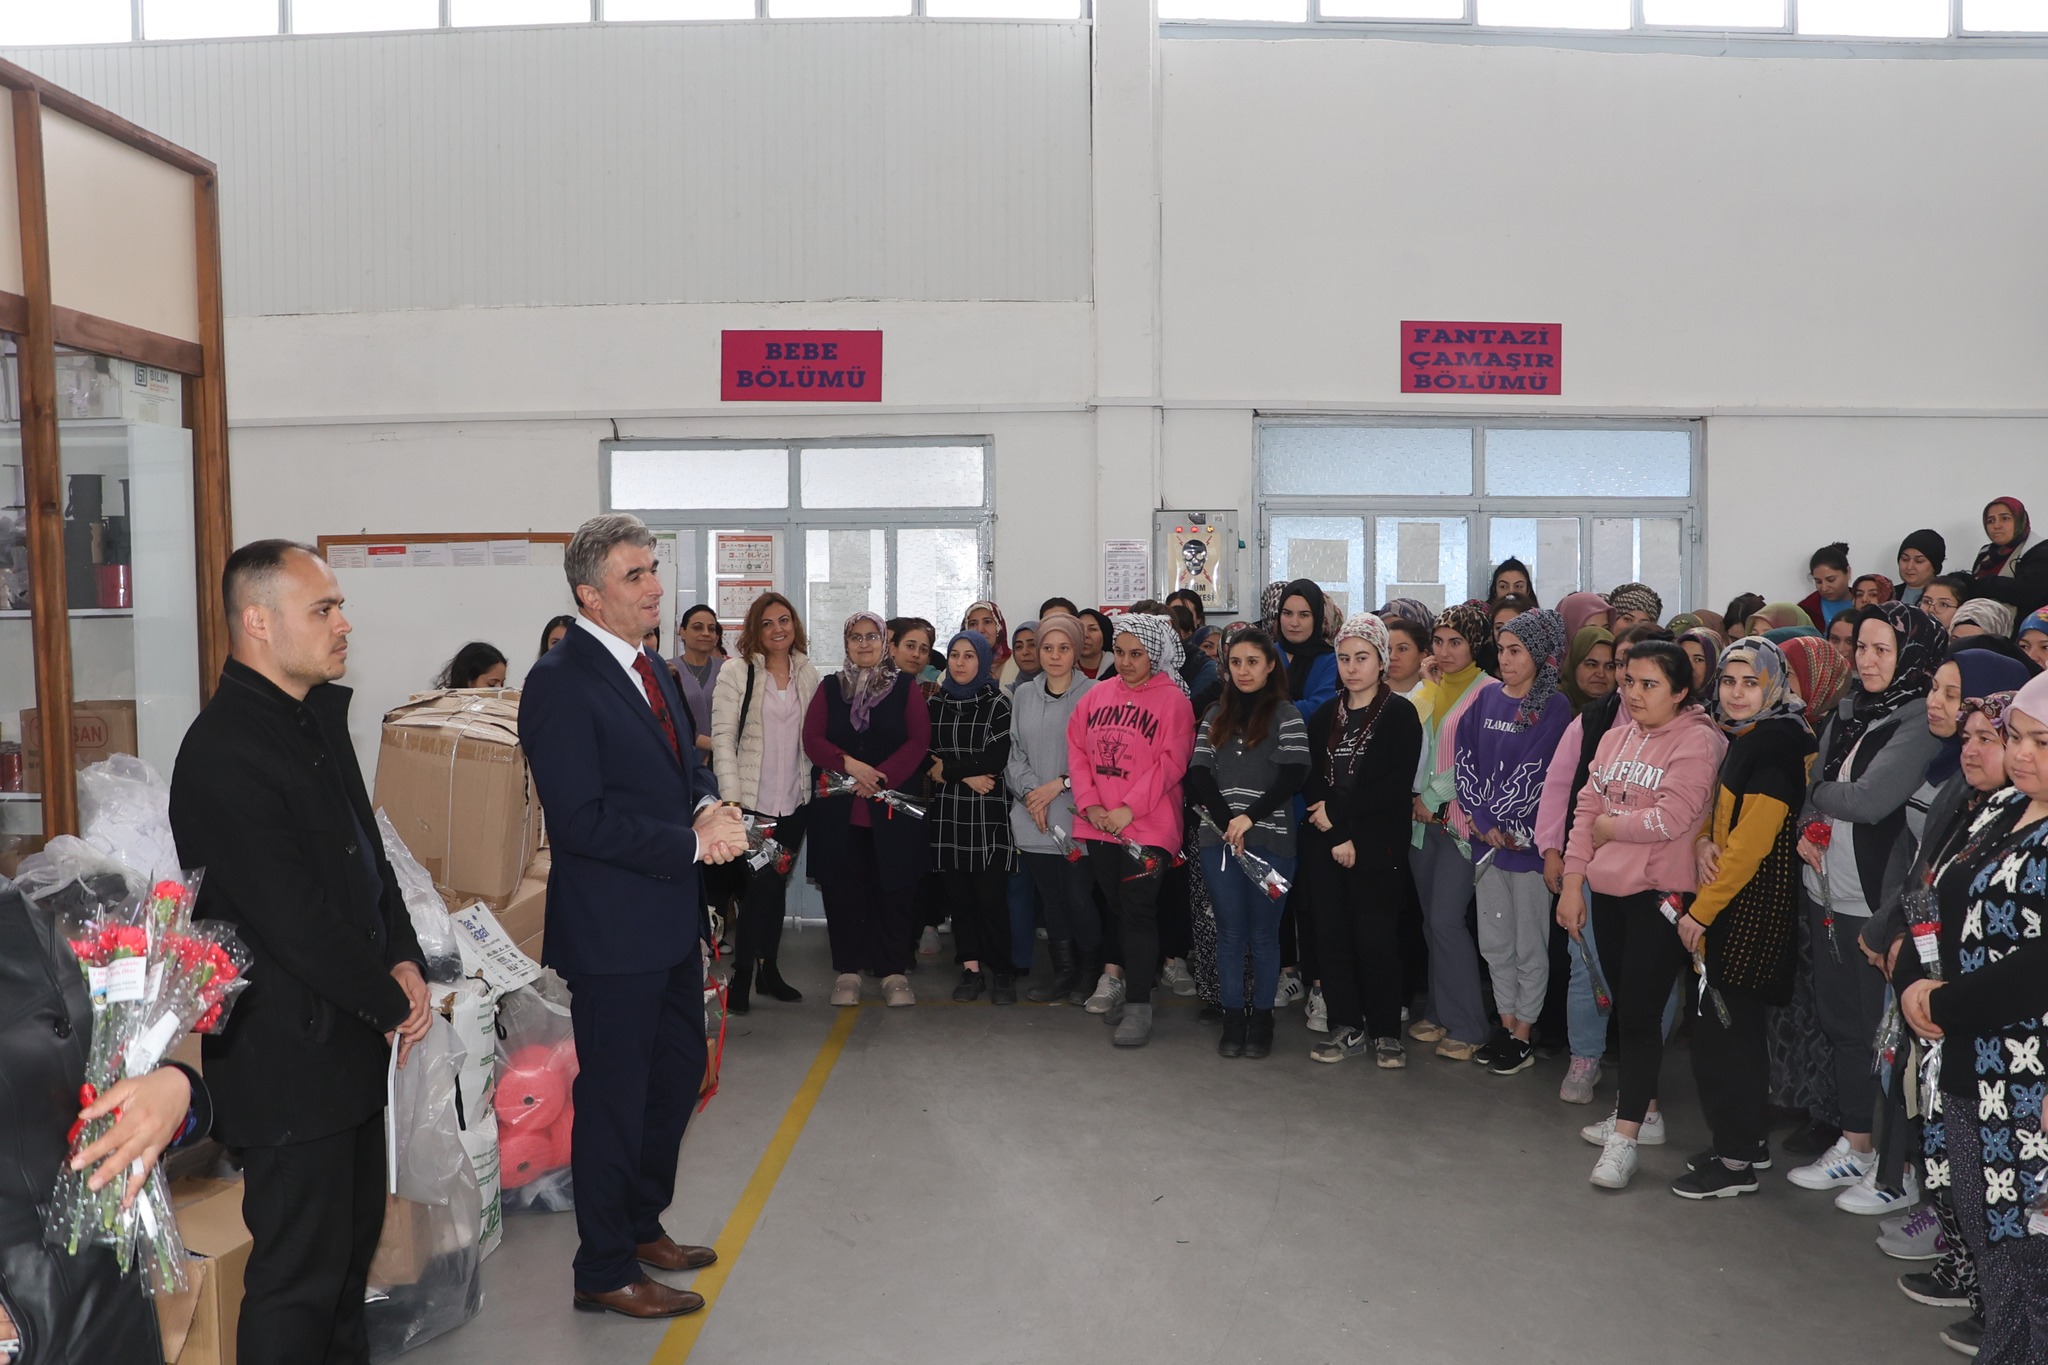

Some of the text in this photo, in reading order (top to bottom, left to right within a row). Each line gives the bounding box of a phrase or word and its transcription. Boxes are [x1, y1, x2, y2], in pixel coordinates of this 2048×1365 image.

[1413, 327, 1549, 345] FANTAZİ
[765, 342, 838, 360] BEBE
[1408, 351, 1554, 371] ÇAMAŞIR
[736, 365, 866, 388] BÖLÜMÜ
[1413, 370, 1548, 390] BÖLÜMÜ
[1086, 704, 1159, 747] MONTANA
